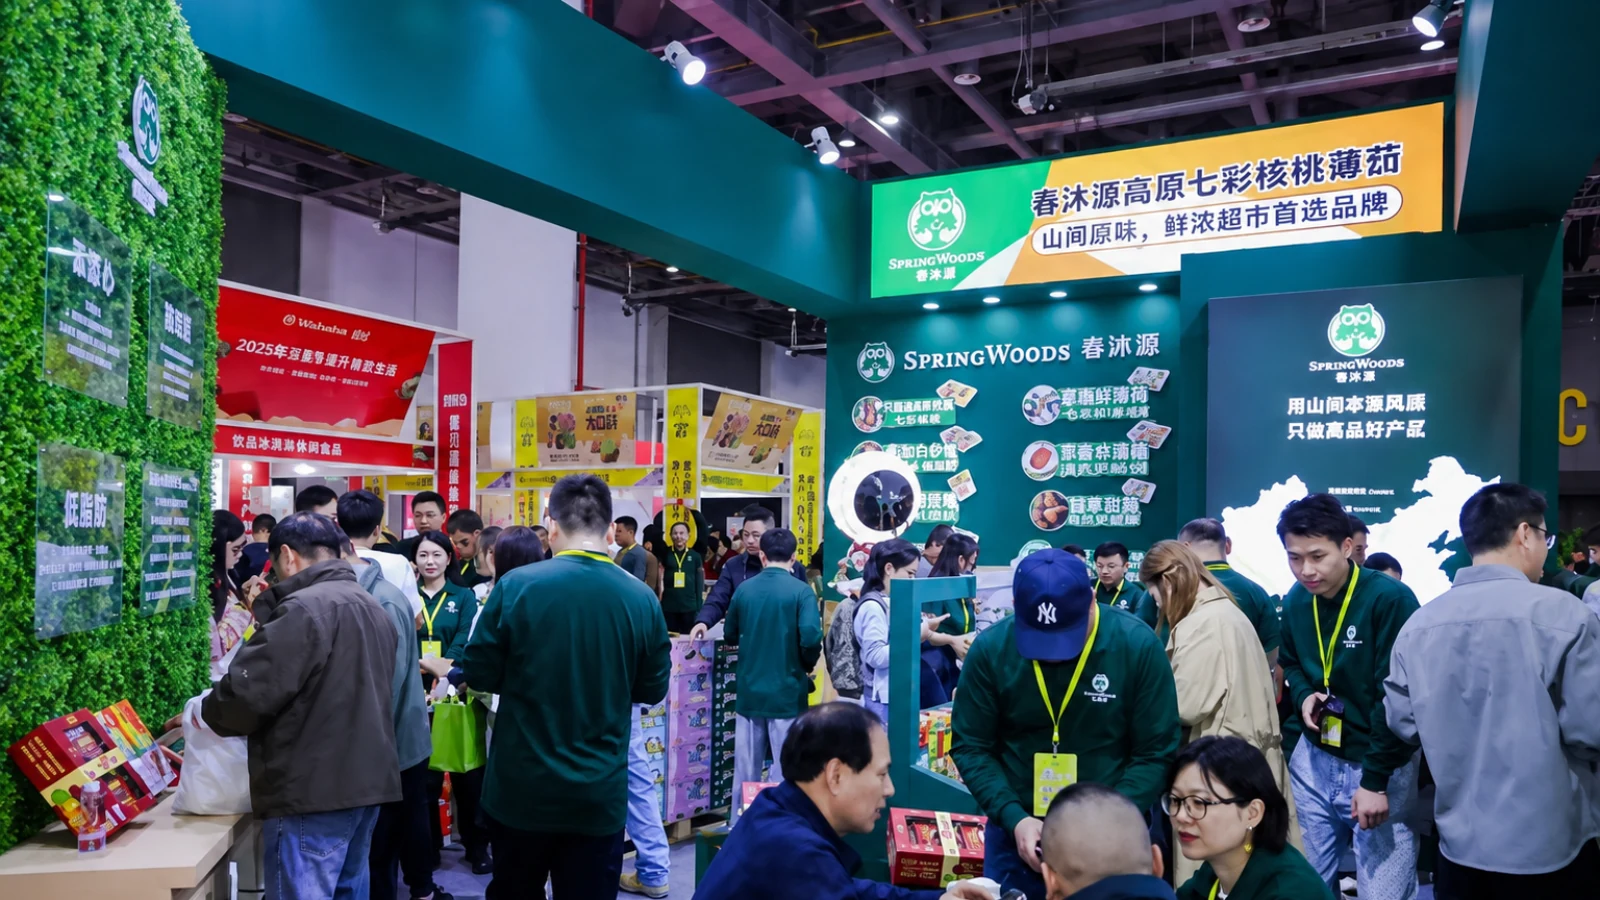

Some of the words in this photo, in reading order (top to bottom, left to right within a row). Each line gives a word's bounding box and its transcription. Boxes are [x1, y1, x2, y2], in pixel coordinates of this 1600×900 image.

[1081, 332, 1161, 360] 春沐源
[1559, 388, 1588, 447] C
[64, 490, 107, 529] 低脂肪
